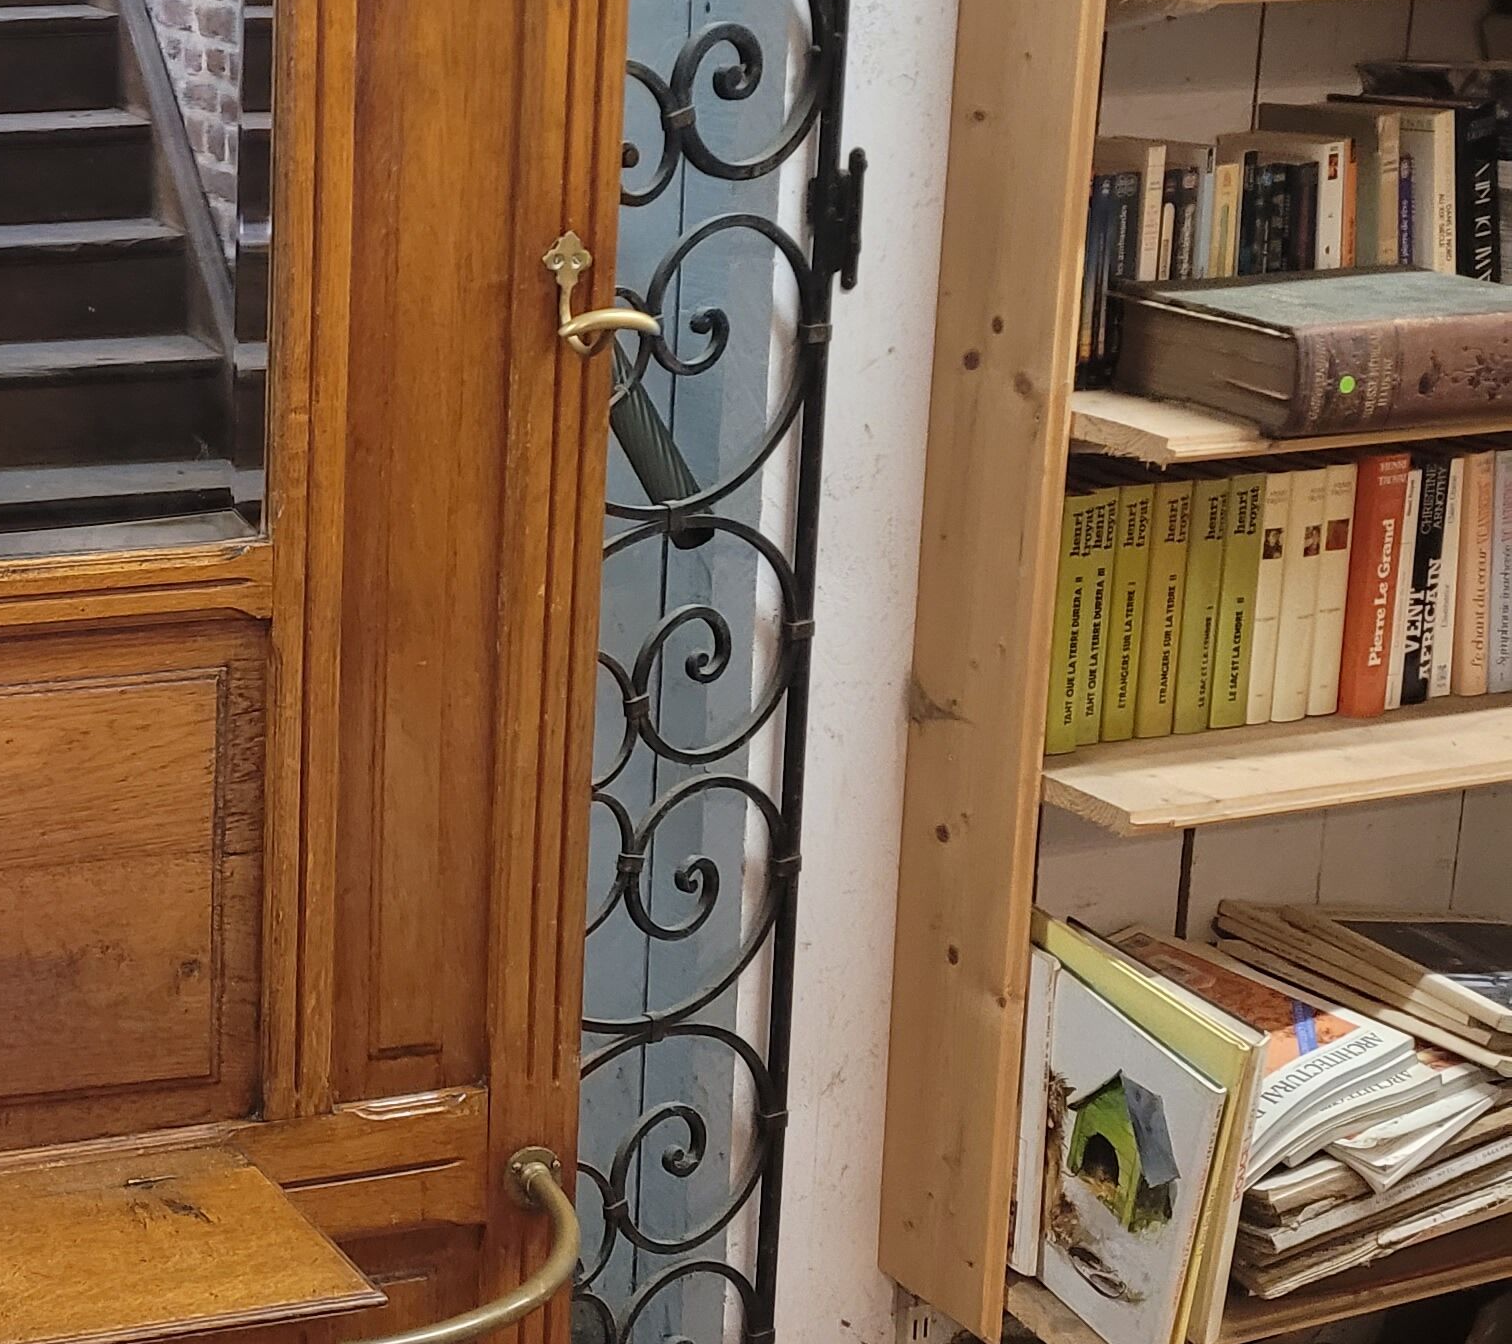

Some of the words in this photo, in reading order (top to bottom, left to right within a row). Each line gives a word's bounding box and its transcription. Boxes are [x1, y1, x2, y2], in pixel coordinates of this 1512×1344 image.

[1234, 490, 1248, 535] henri
[1246, 486, 1260, 536] troyat
[1420, 463, 1437, 535] CHRISTINE
[1434, 465, 1448, 529] ARNOTHY
[1069, 511, 1085, 558] henri
[1081, 507, 1095, 558] troyat
[1092, 504, 1106, 550] henri
[1103, 499, 1117, 550] troyat
[1123, 503, 1137, 548] henri
[1135, 497, 1150, 548] troyat
[1164, 498, 1178, 544] henri
[1176, 494, 1190, 544] troyat
[1205, 495, 1219, 541] henri
[1377, 518, 1396, 578] Grand
[1071, 587, 1083, 628] DURERA
[1093, 580, 1105, 619] DURERA
[1125, 589, 1136, 618] TERRE
[1166, 585, 1177, 614] TERRE
[1374, 582, 1389, 606] Le
[1474, 585, 1486, 609] du
[1090, 621, 1101, 652] TERRE
[1124, 618, 1133, 632] LA
[1164, 615, 1175, 628] LA
[1232, 610, 1244, 644] CENDRE
[1367, 607, 1387, 667] Pierre
[1405, 587, 1425, 655] VENT
[1418, 557, 1441, 680] AFRICAIN
[1473, 610, 1485, 651] chant
[1068, 629, 1079, 659] TERRE
[1121, 634, 1132, 652] SUR
[1162, 630, 1173, 647] SUR
[1231, 644, 1241, 658] LA
[1066, 660, 1077, 675] LA
[1088, 652, 1099, 667] LA
[1064, 677, 1075, 698] QUE
[1086, 669, 1097, 690] QUE
[1227, 690, 1237, 702] LE
[1228, 670, 1239, 689] SAC
[1063, 701, 1073, 726] TANT
[1085, 692, 1095, 717] TANT
[1264, 1032, 1384, 1104] ARCHITECTURAL
